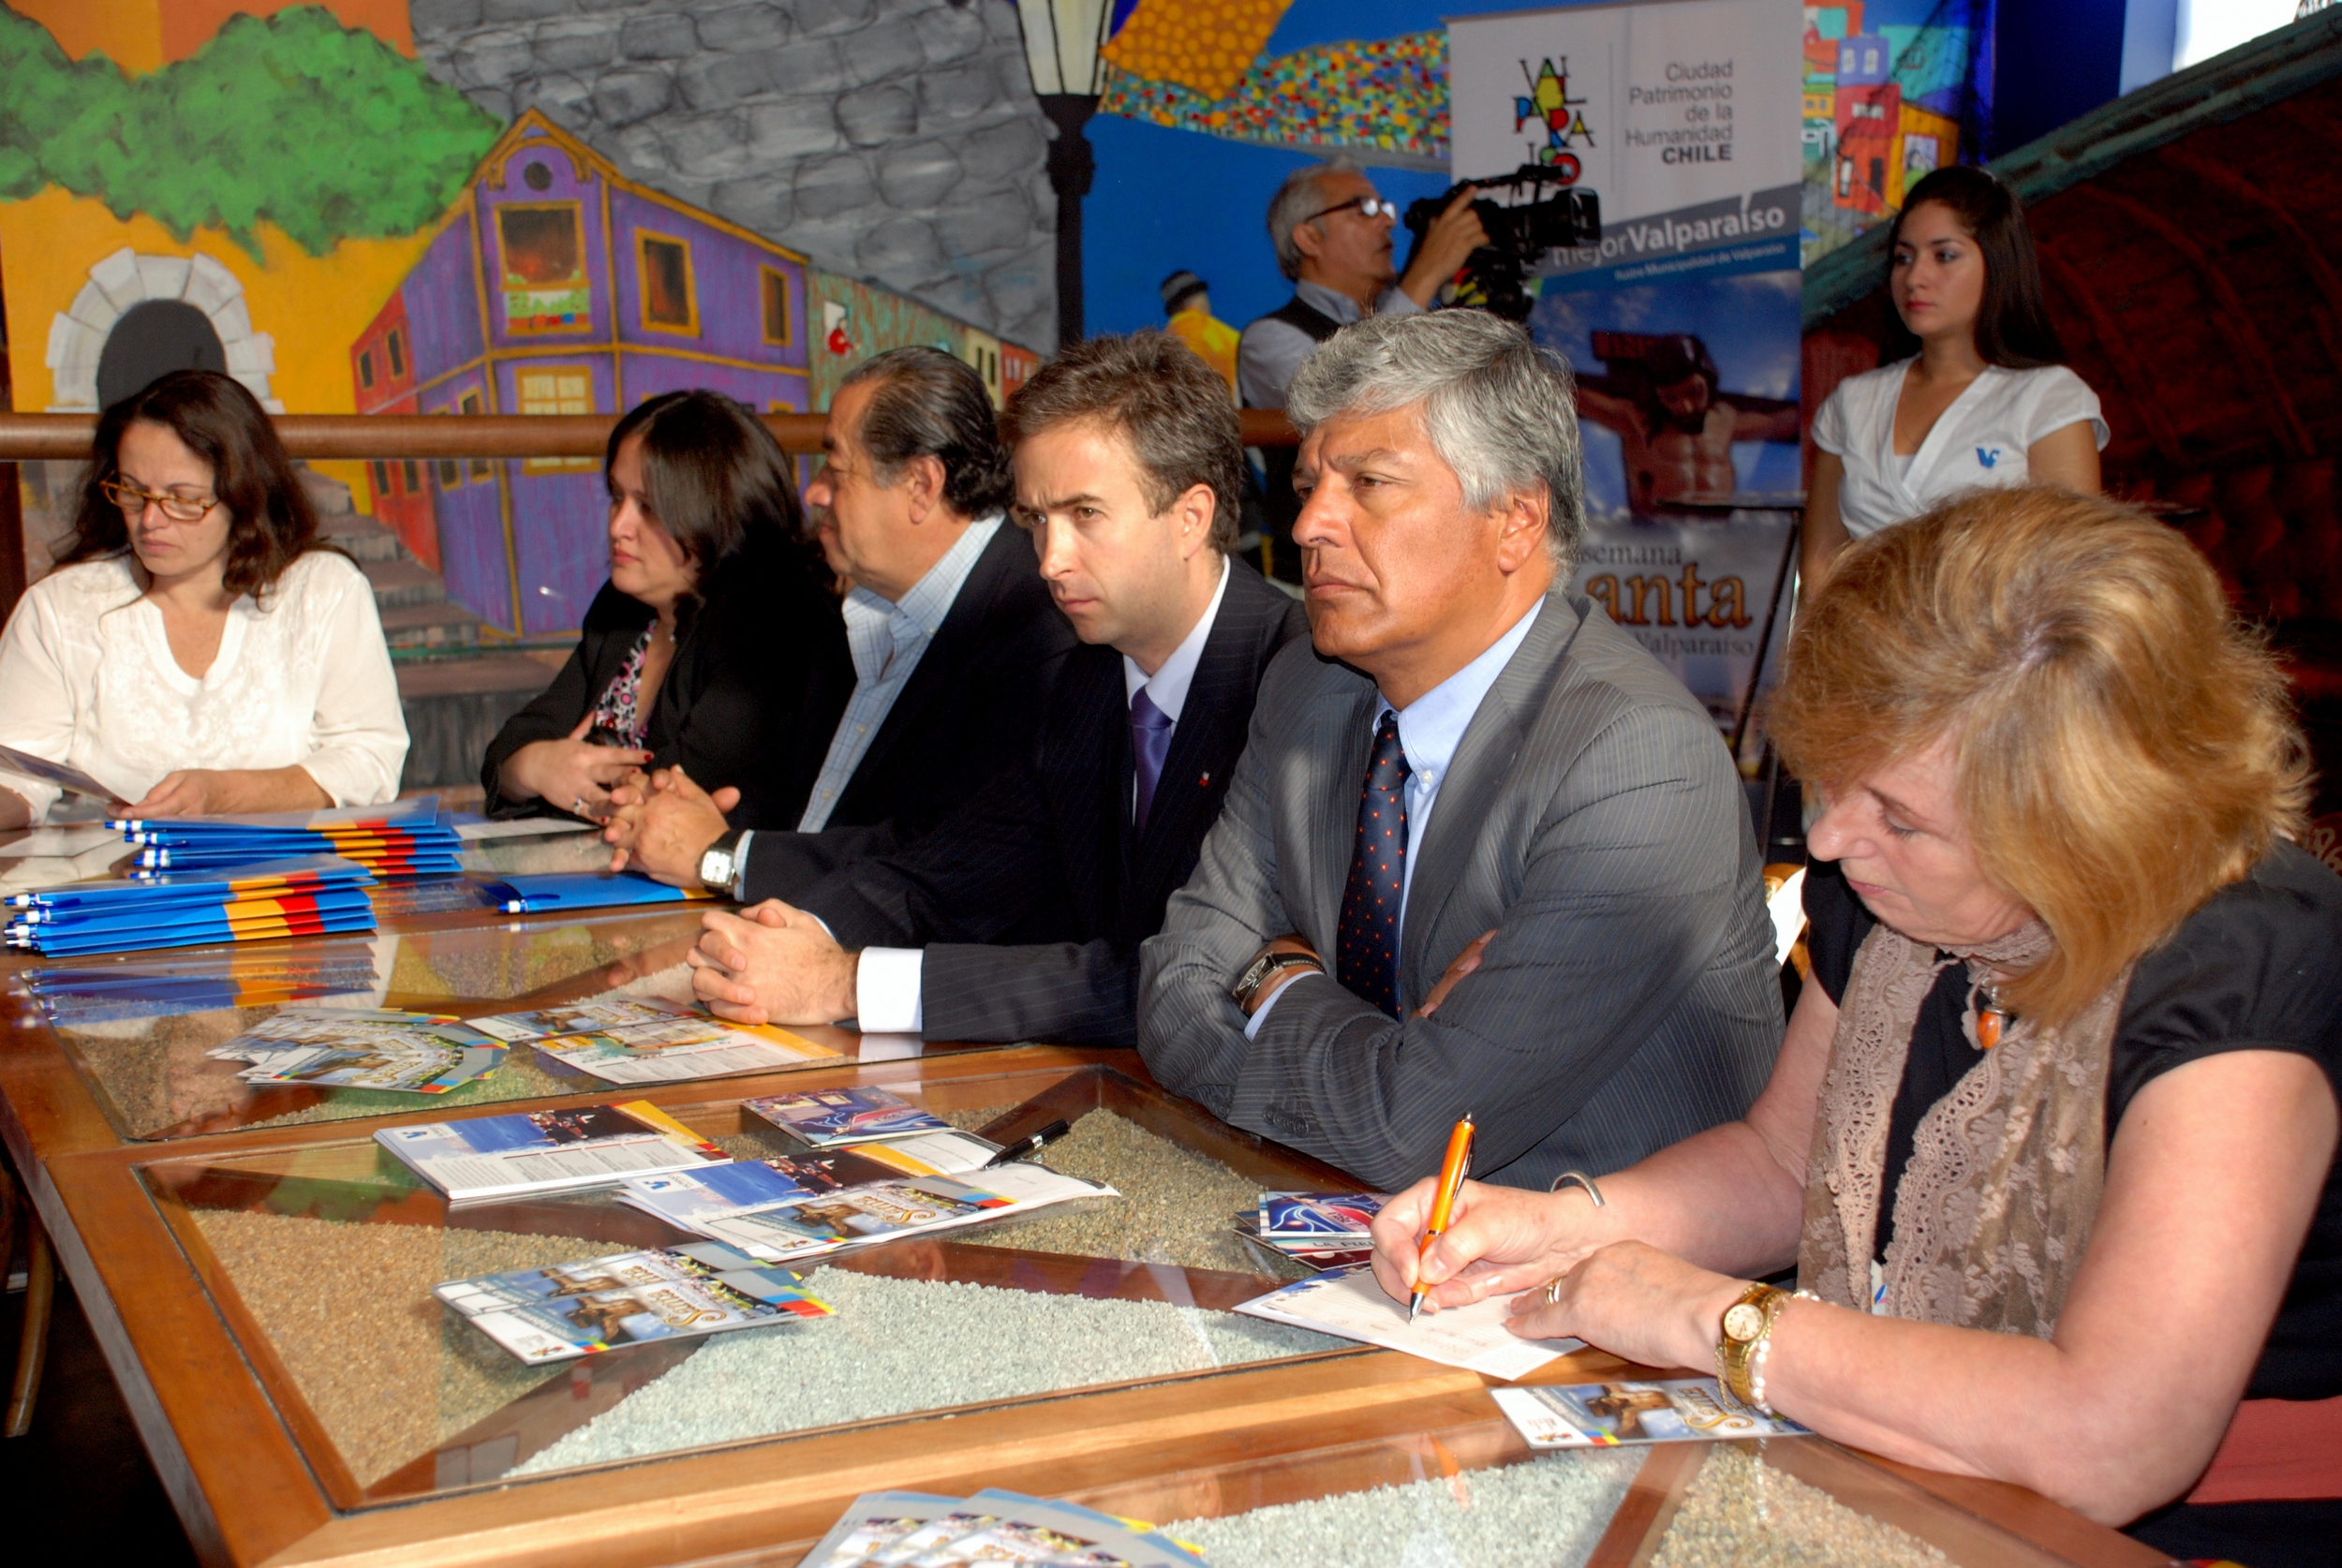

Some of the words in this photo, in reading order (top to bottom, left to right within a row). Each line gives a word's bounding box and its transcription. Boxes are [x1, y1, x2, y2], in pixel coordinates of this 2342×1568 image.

[1666, 60, 1733, 83] Ciudad
[1629, 83, 1733, 106] Patrimonio
[1685, 104, 1711, 121] de
[1716, 104, 1733, 120] la
[1624, 126, 1733, 147] Humanidad
[1662, 144, 1733, 165] CHILE
[1583, 545, 1682, 566] semana
[1586, 562, 1753, 629] anta
